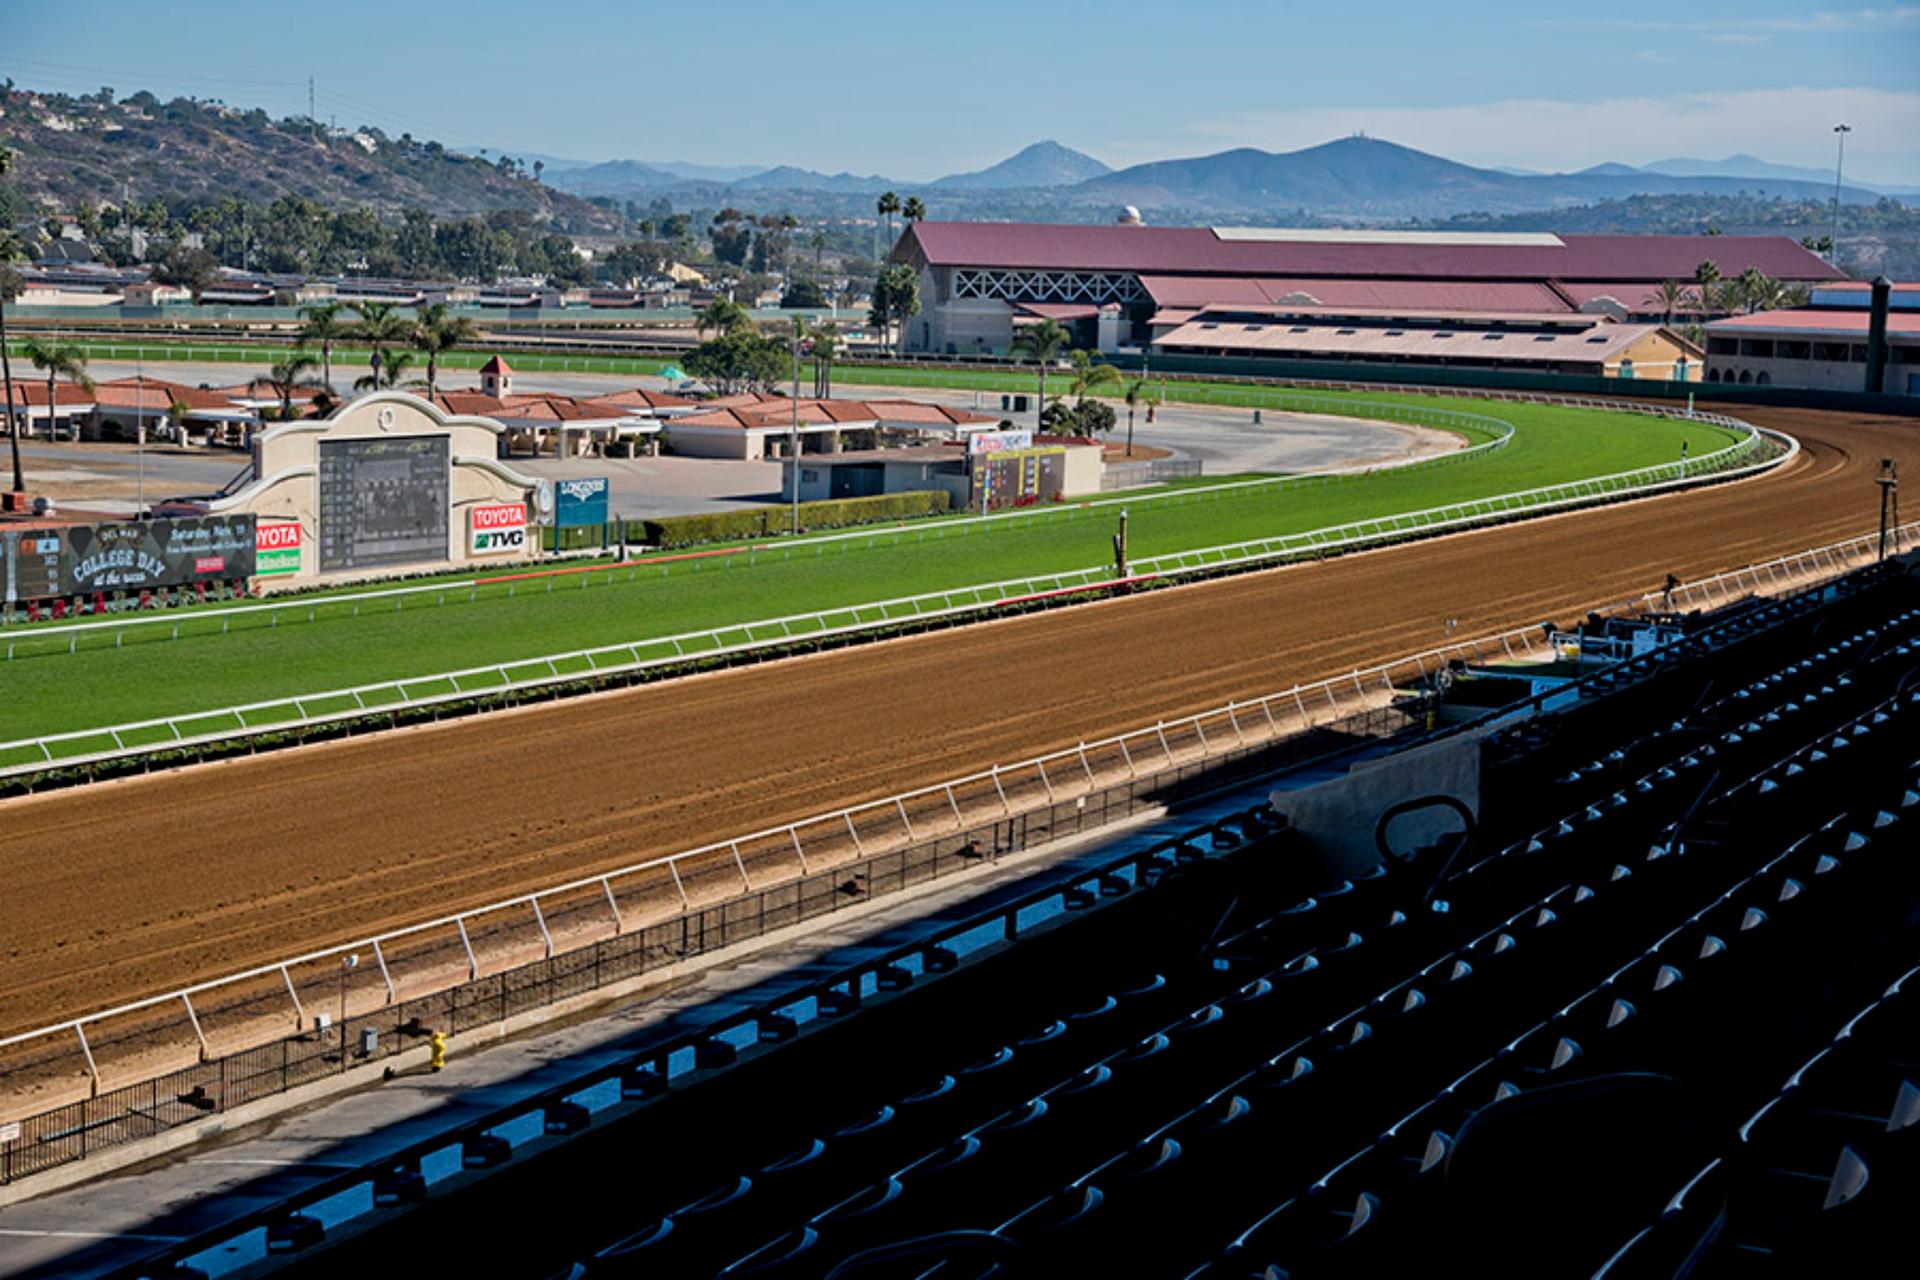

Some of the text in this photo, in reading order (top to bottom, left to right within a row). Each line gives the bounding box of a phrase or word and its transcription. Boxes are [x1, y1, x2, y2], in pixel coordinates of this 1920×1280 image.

[475, 507, 523, 525] TOYOTA
[490, 531, 523, 547] TVG
[74, 550, 135, 583] COLLEGE
[138, 552, 165, 578] DAY
